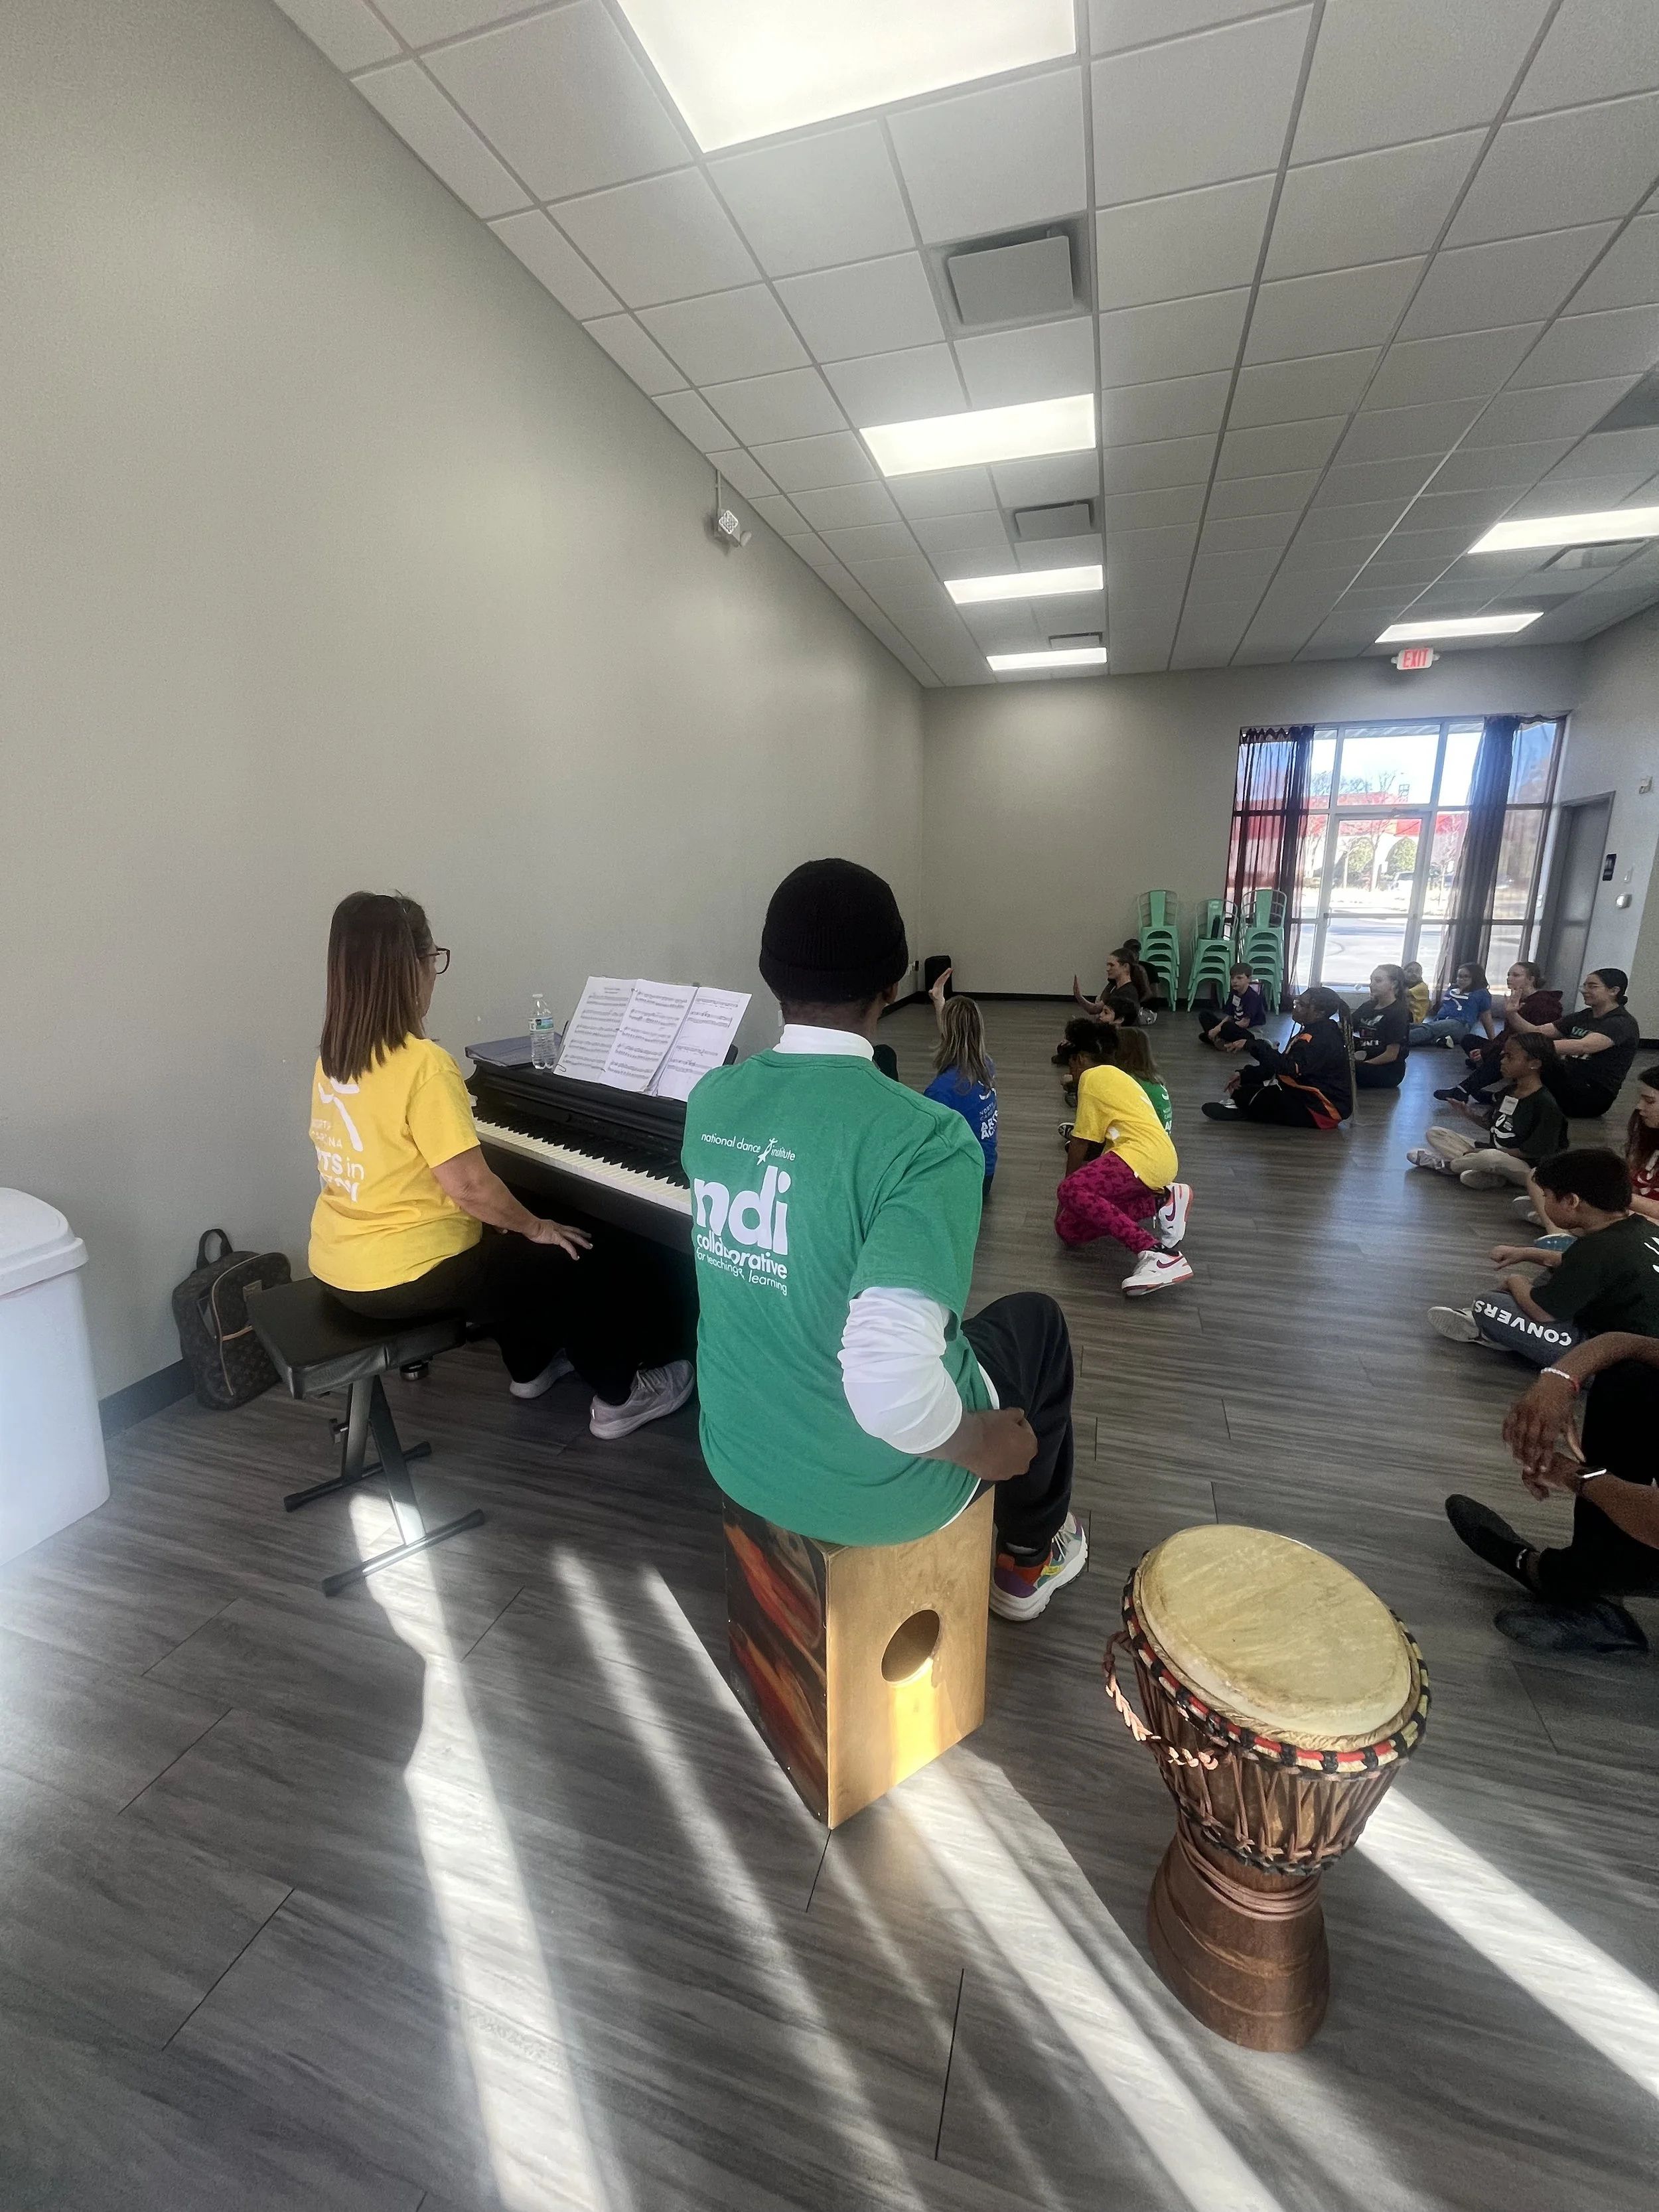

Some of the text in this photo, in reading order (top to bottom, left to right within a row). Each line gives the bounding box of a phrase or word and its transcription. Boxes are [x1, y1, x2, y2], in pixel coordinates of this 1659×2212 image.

[1403, 648, 1430, 668] EXIT
[701, 1133, 796, 1161] national dance institute
[346, 1157, 364, 1180] in
[693, 1165, 791, 1256] ndi
[707, 1254, 739, 1277] teaching
[749, 1270, 787, 1296] learning
[1474, 1300, 1572, 1346] CONVERS
